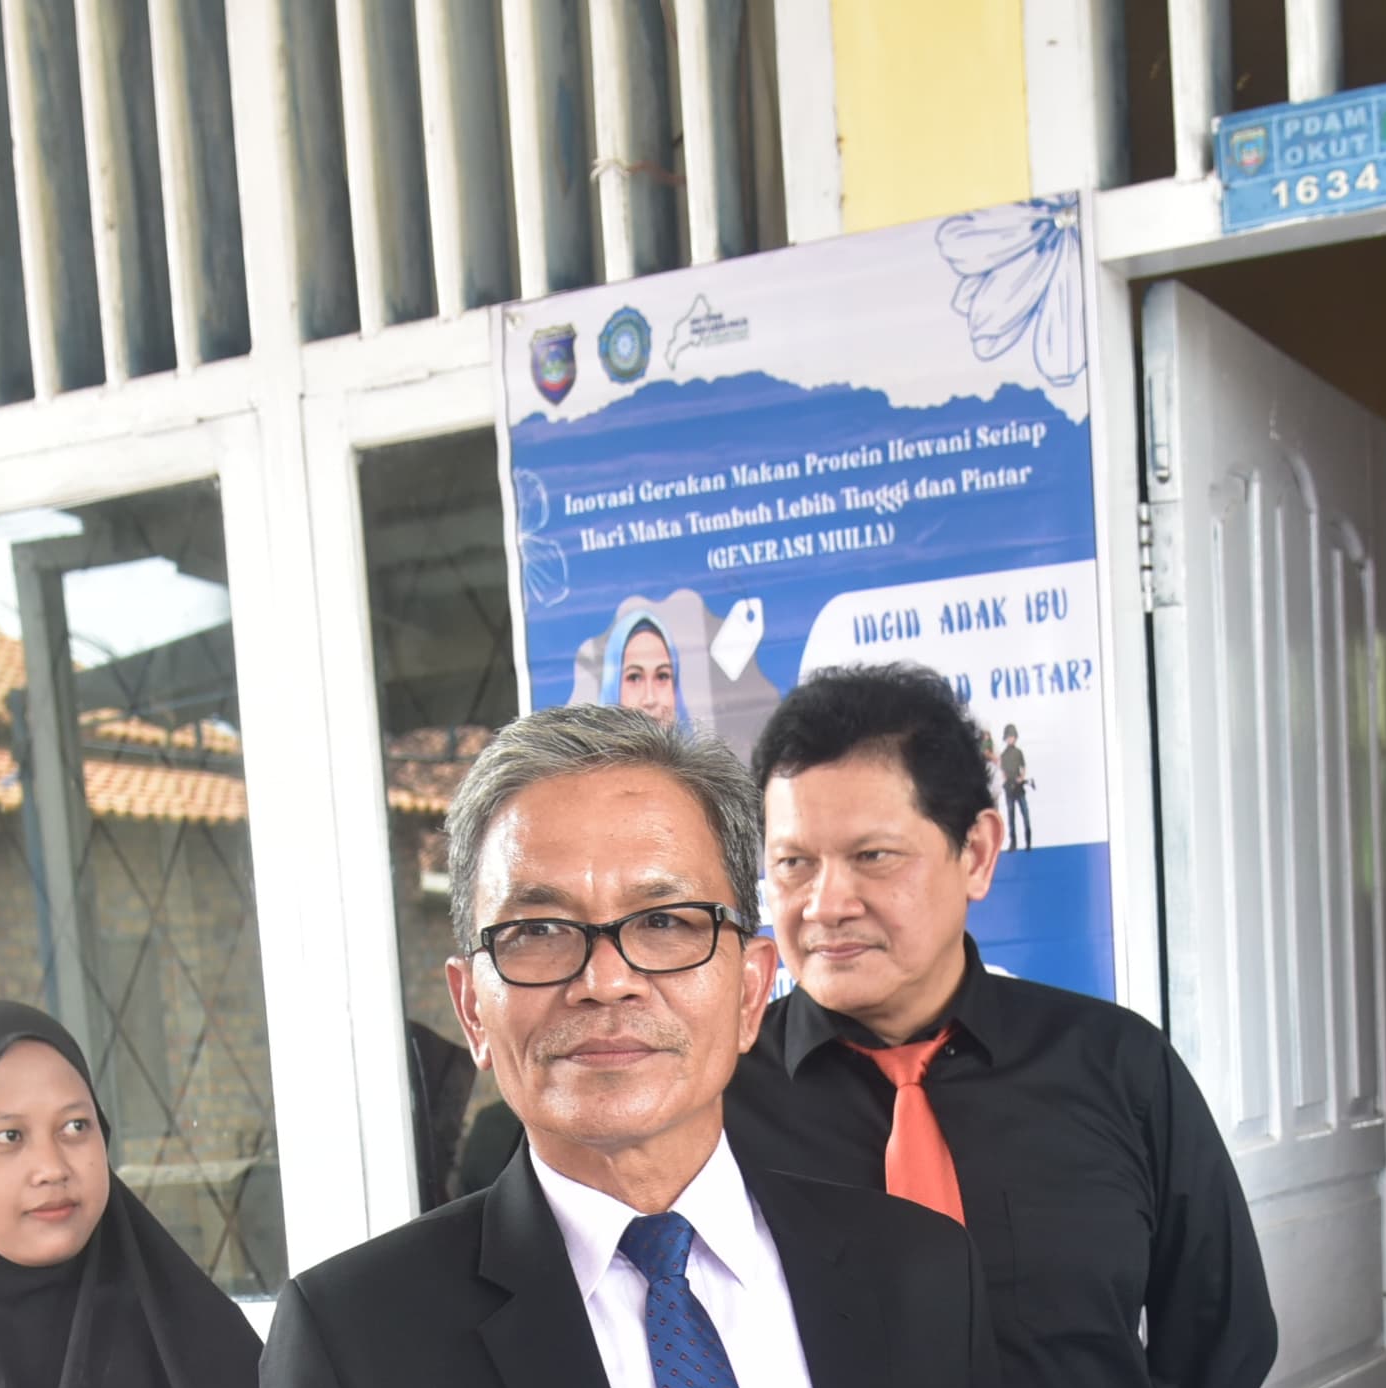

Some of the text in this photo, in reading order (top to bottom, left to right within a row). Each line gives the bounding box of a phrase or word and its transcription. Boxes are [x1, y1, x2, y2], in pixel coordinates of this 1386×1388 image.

[1283, 106, 1368, 140] PDAM
[1284, 133, 1369, 166] OKUT
[1271, 162, 1380, 209] 1634
[564, 420, 1047, 516] Inovasi Gerakan Makan Protein Hewani Setiap
[580, 465, 1033, 552] Hari Maka Tumbuh Lebih Tinggi dan Pintar
[707, 533, 813, 572] (GENERASI
[854, 588, 1069, 645] INGIN ANAK IBU
[990, 659, 1093, 700] PINTAR?
